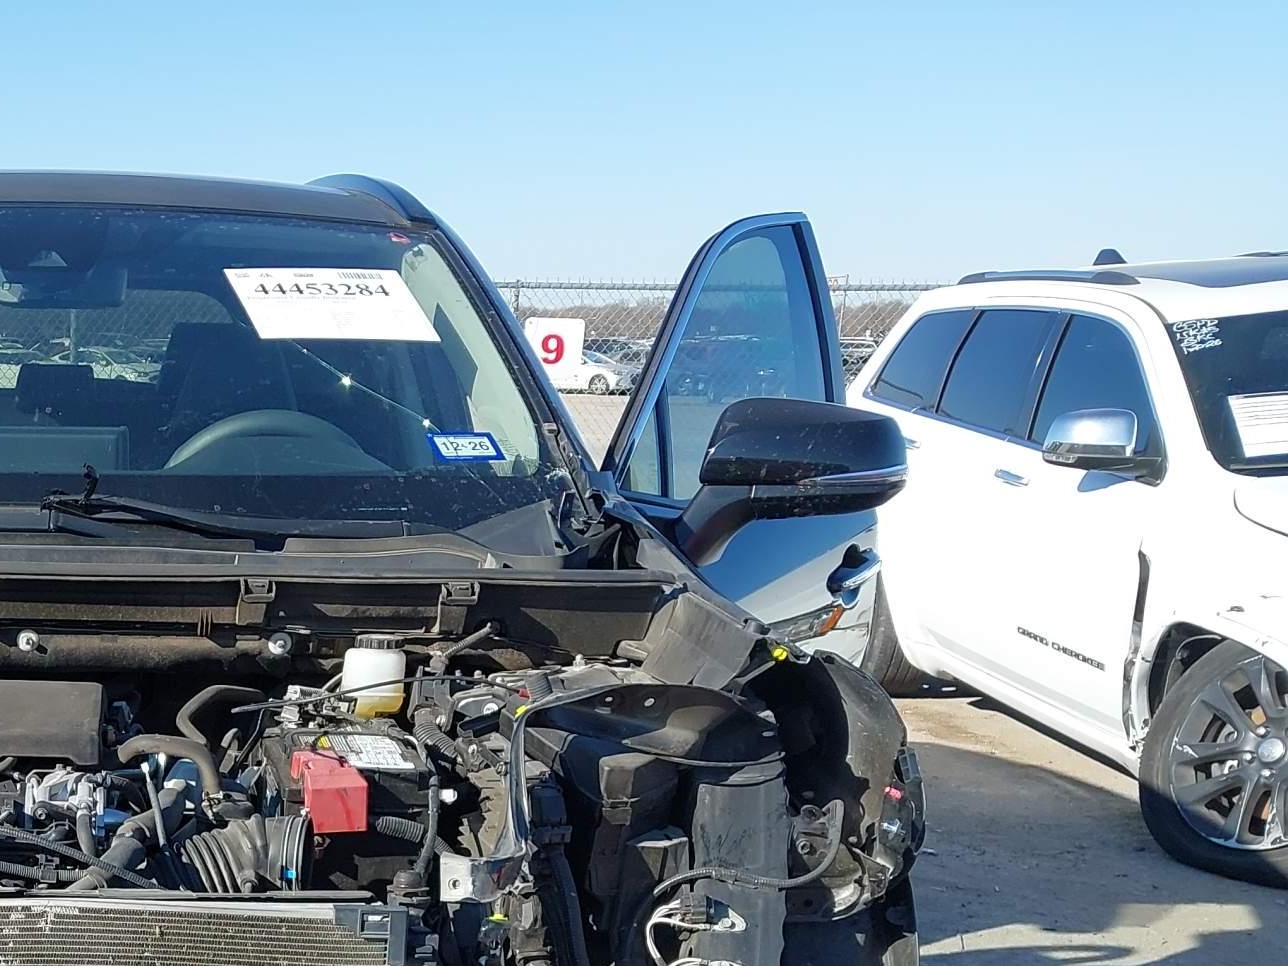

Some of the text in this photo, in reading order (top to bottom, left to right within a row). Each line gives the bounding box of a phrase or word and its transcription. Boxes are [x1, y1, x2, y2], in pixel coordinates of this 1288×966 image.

[254, 282, 391, 297] 44453284
[541, 333, 565, 365] 9
[1017, 626, 1106, 673] GRAND CHEROKEE
